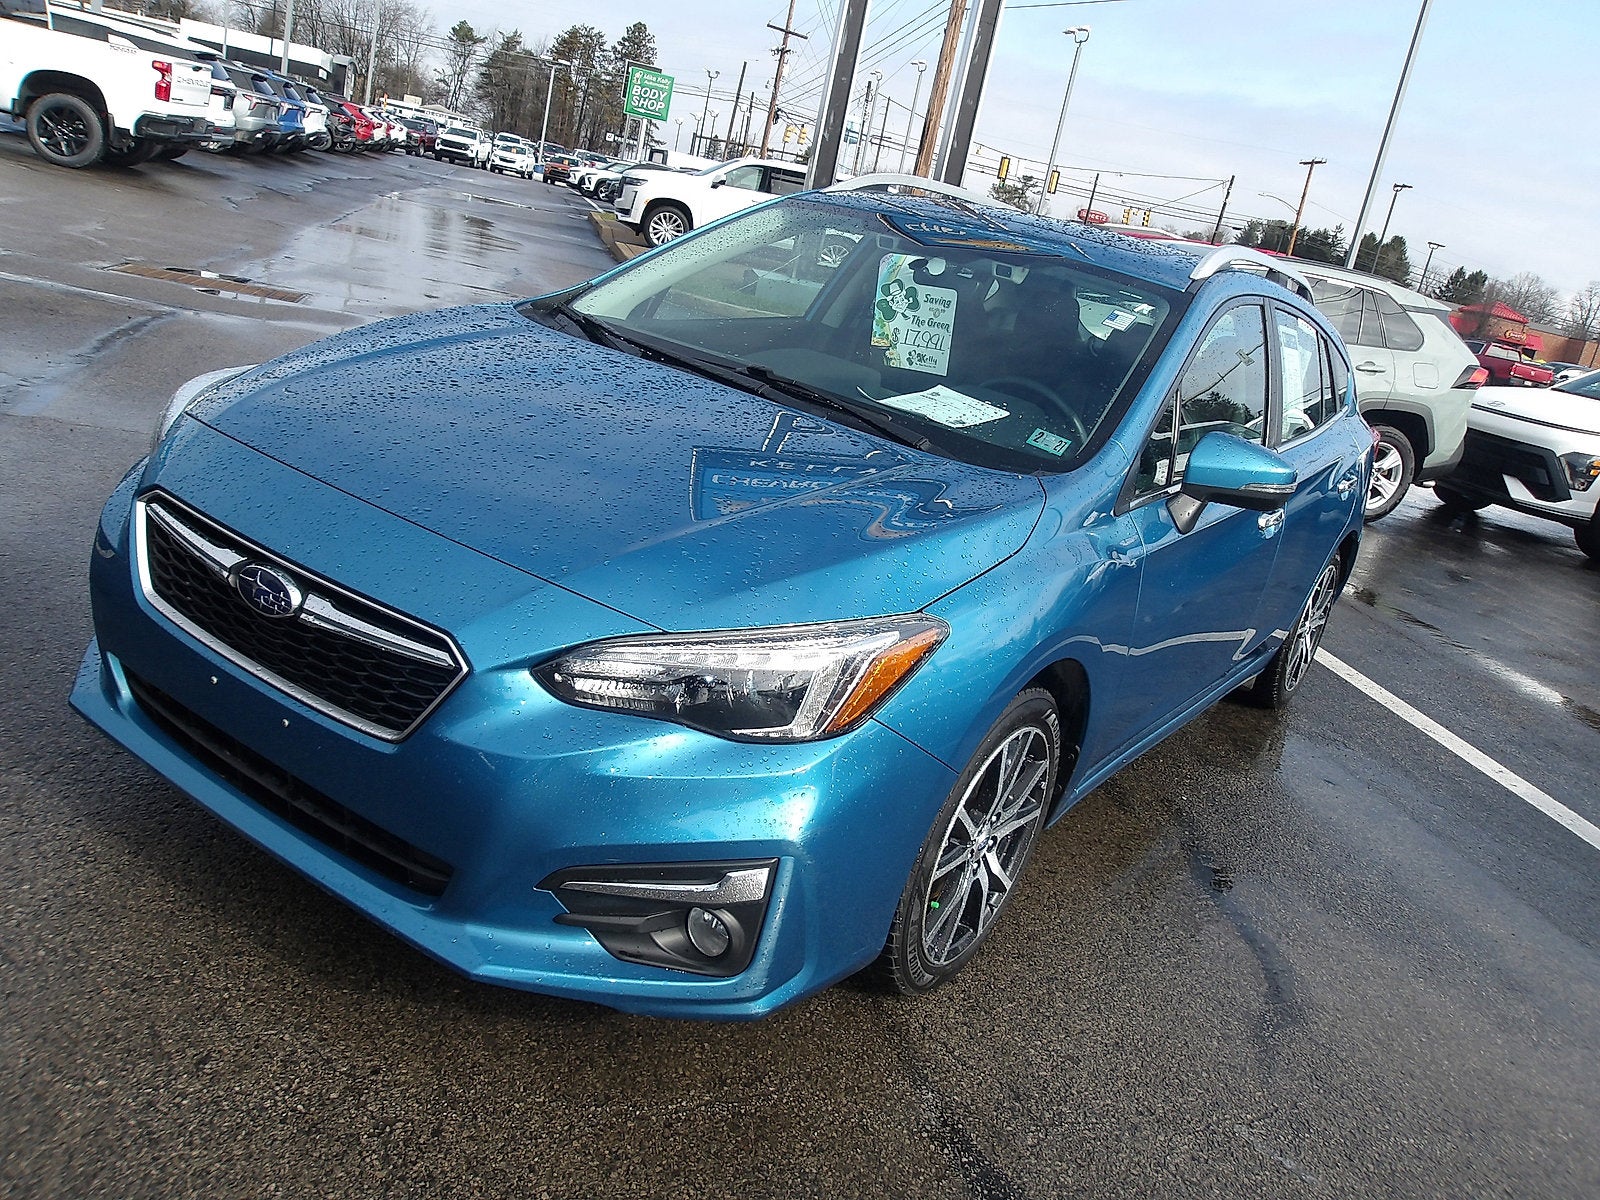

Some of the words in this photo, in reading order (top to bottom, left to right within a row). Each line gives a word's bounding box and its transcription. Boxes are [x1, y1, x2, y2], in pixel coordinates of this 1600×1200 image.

[632, 85, 667, 101] BODY
[631, 95, 666, 111] SHOP
[923, 293, 952, 309] Saving
[911, 315, 926, 327] The
[927, 318, 951, 333] Green
